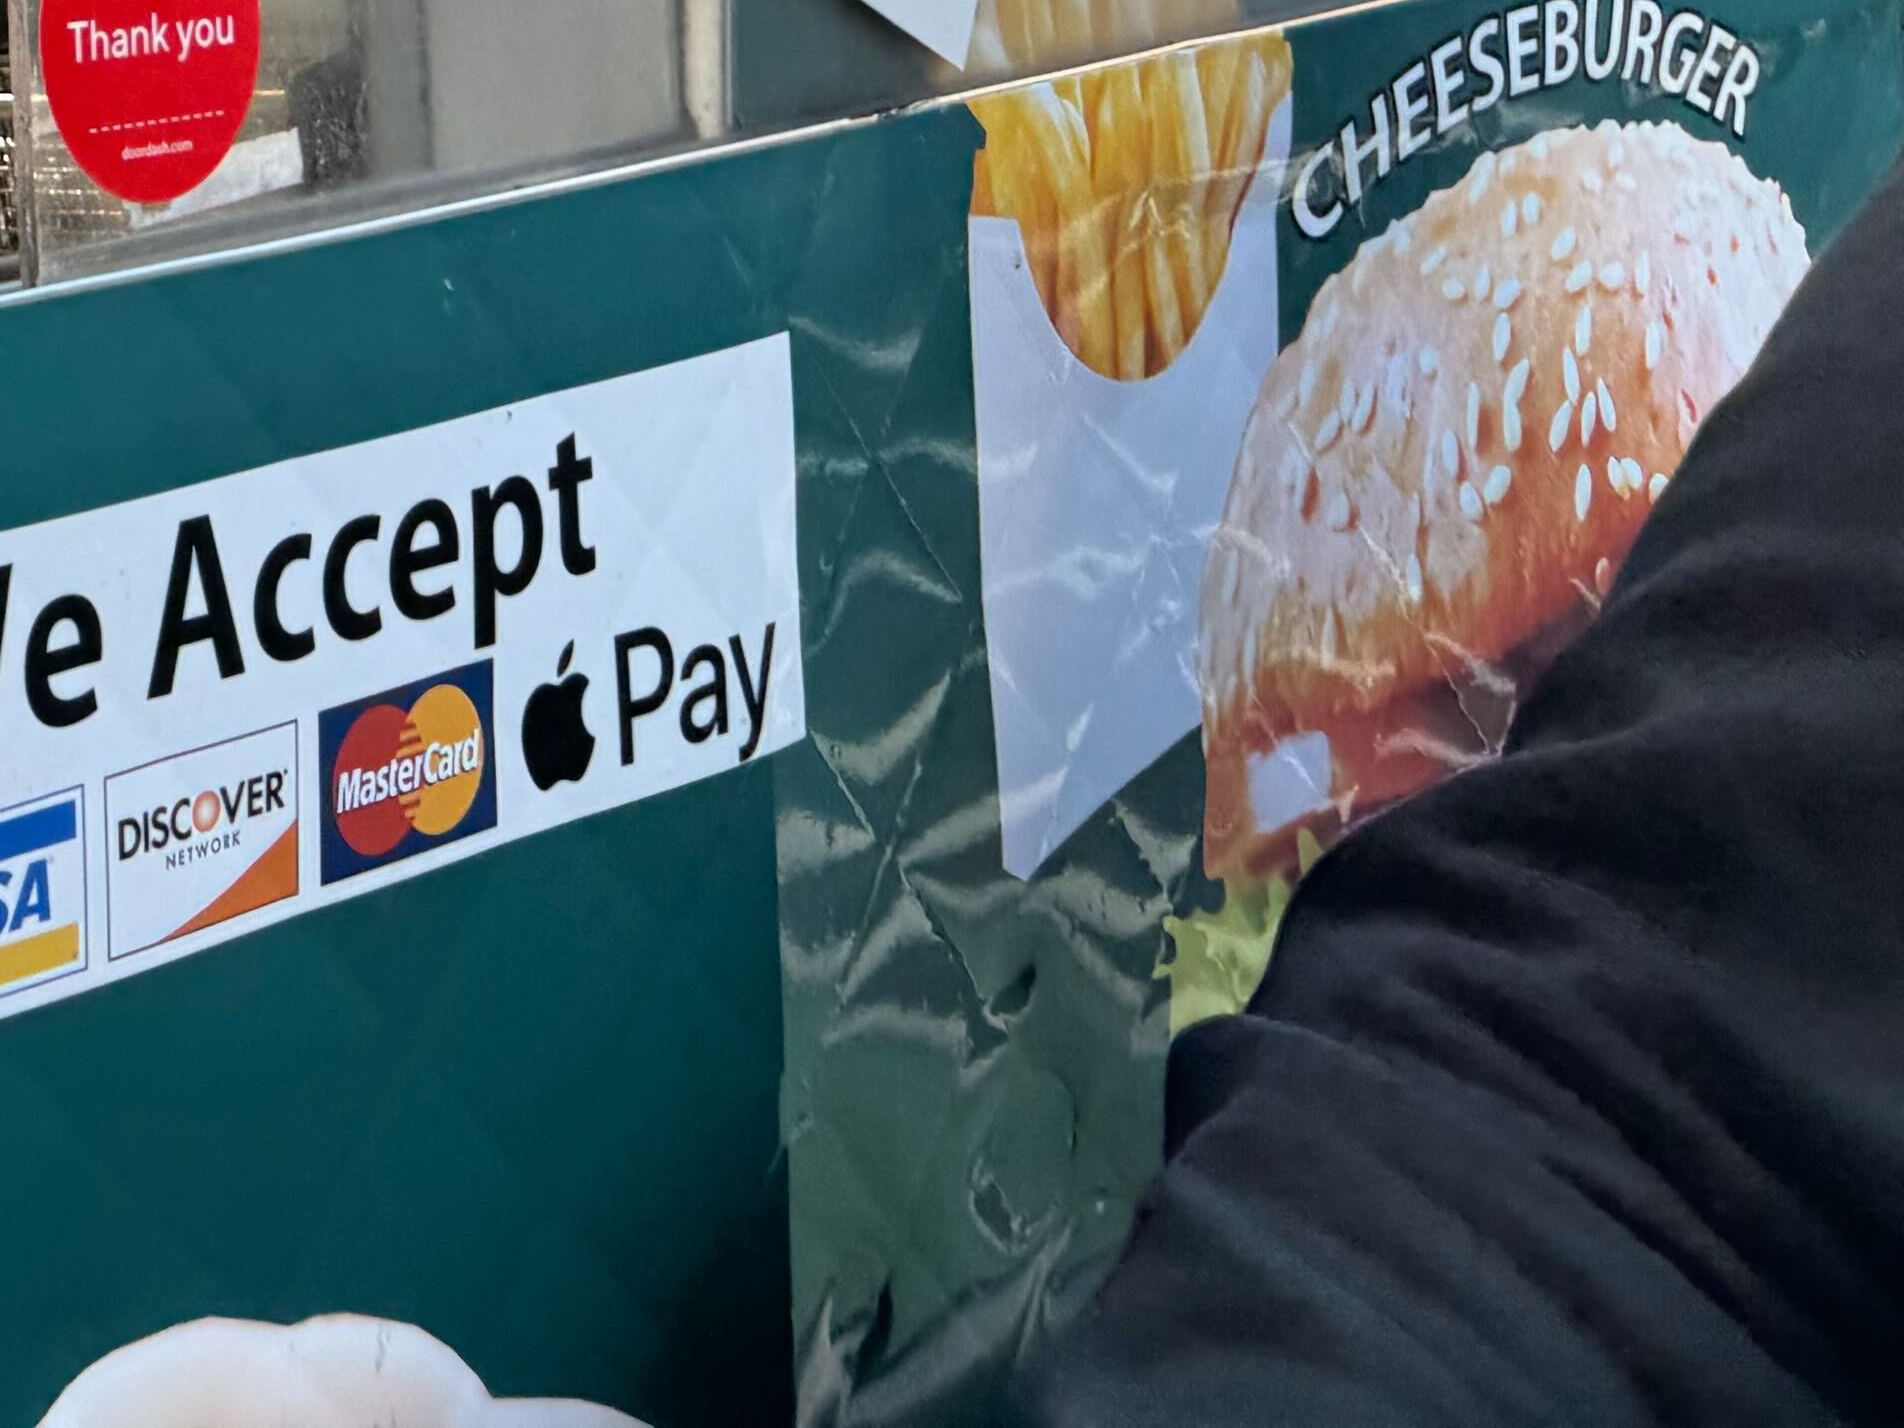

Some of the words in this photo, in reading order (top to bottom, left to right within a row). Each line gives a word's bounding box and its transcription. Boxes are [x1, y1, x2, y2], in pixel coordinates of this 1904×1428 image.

[67, 11, 171, 64] Thank
[175, 15, 235, 63] you
[146, 431, 598, 700] Accept
[613, 622, 776, 767] Pay
[118, 769, 285, 862] DISCOVER
[336, 728, 480, 814] MasterCard
[164, 830, 241, 871] NETWORK
